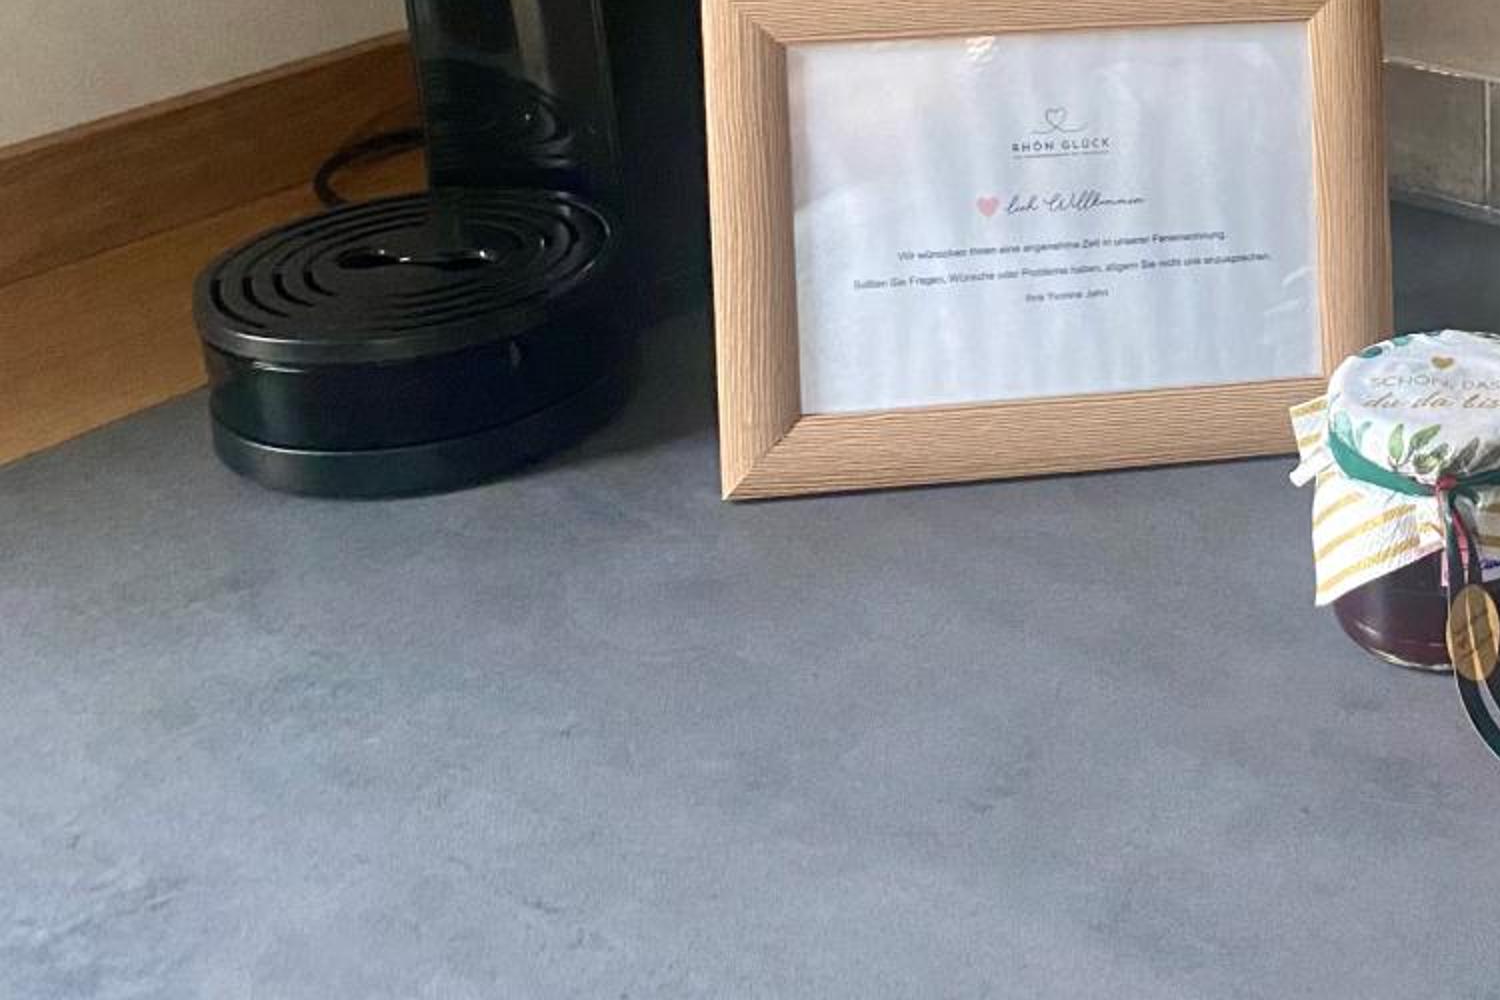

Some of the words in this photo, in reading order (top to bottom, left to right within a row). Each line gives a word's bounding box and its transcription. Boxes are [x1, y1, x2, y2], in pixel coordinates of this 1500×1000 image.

[1061, 137, 1110, 150] GLÜCK
[917, 247, 967, 260] wünschen
[1023, 241, 1080, 254] angenehme
